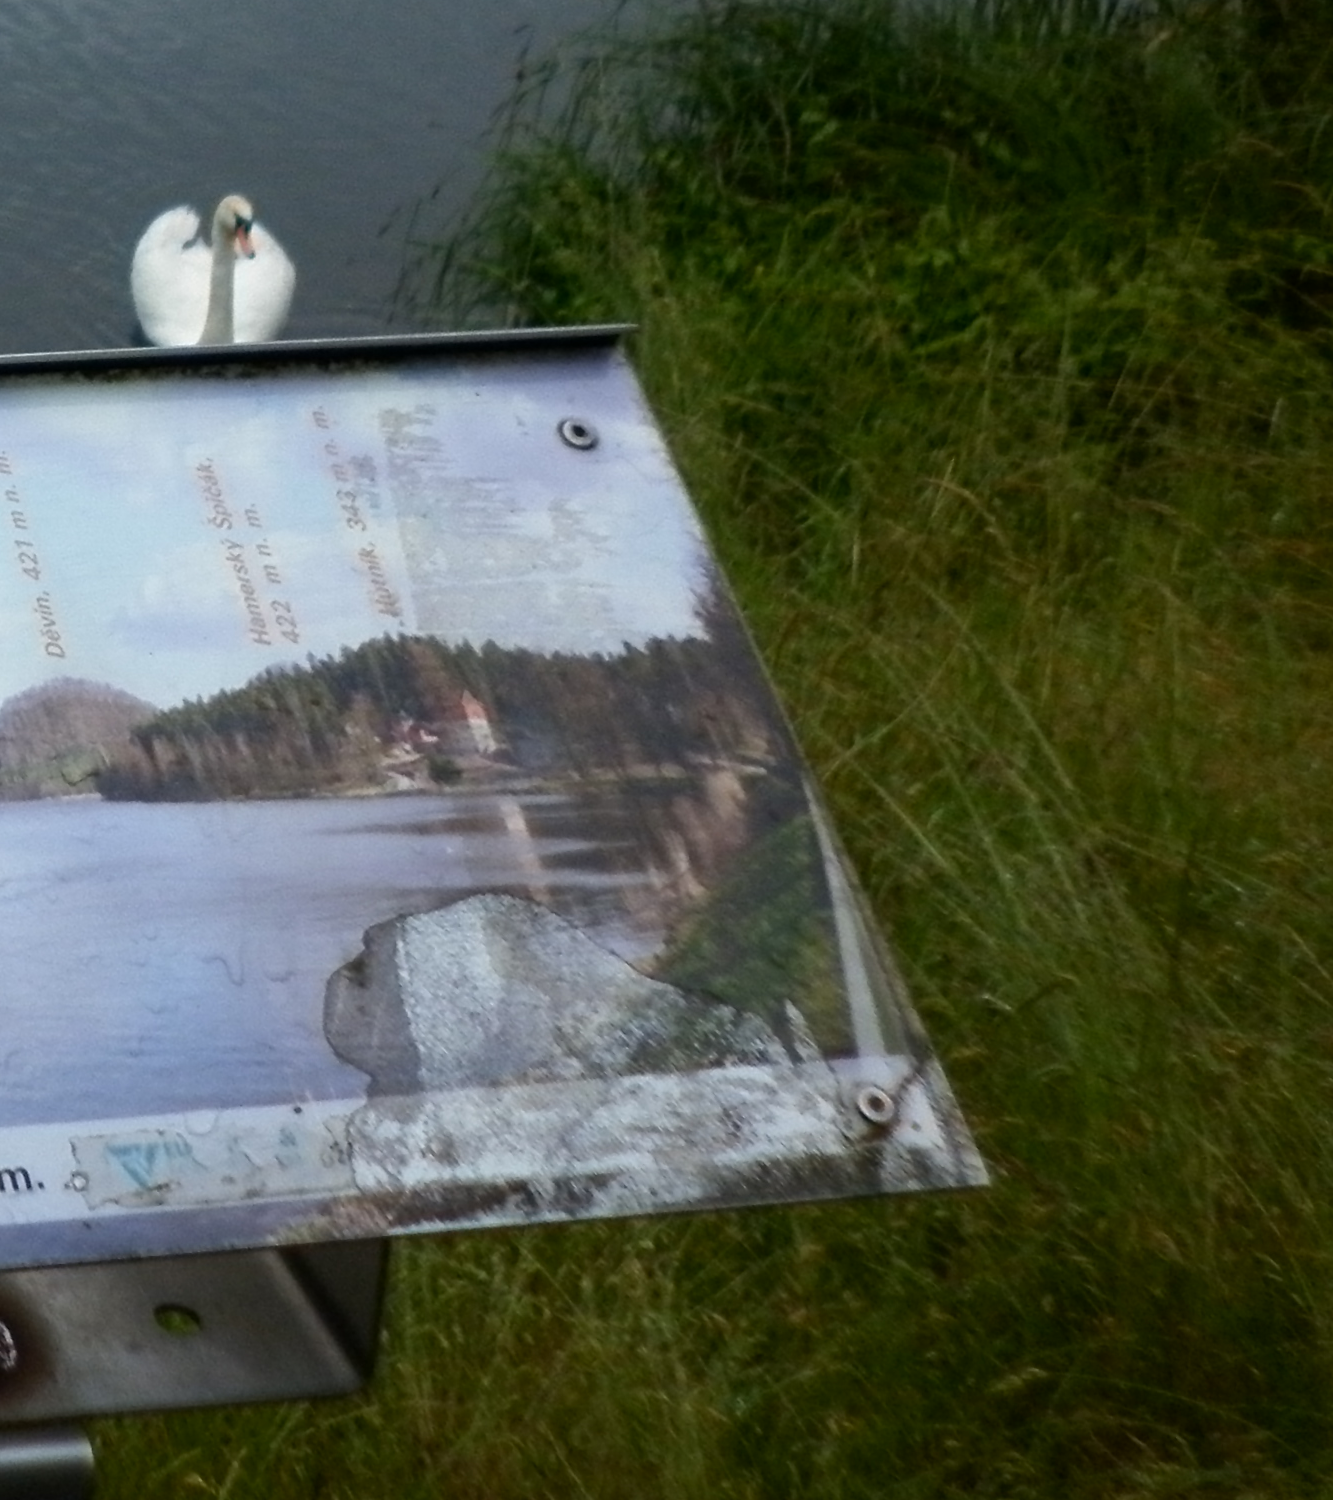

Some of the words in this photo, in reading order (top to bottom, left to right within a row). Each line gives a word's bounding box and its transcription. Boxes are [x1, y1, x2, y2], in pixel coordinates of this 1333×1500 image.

[313, 406, 328, 430] m.
[332, 463, 349, 482] m
[6, 485, 20, 503] n.
[197, 457, 233, 530] Špičák,
[12, 511, 27, 529] m
[246, 503, 263, 528] m.
[258, 538, 272, 557] n.
[16, 540, 41, 580] 421
[267, 565, 282, 584] m
[223, 538, 271, 646] Hamerský
[35, 591, 65, 659] Děvín,
[271, 599, 299, 644] 422
